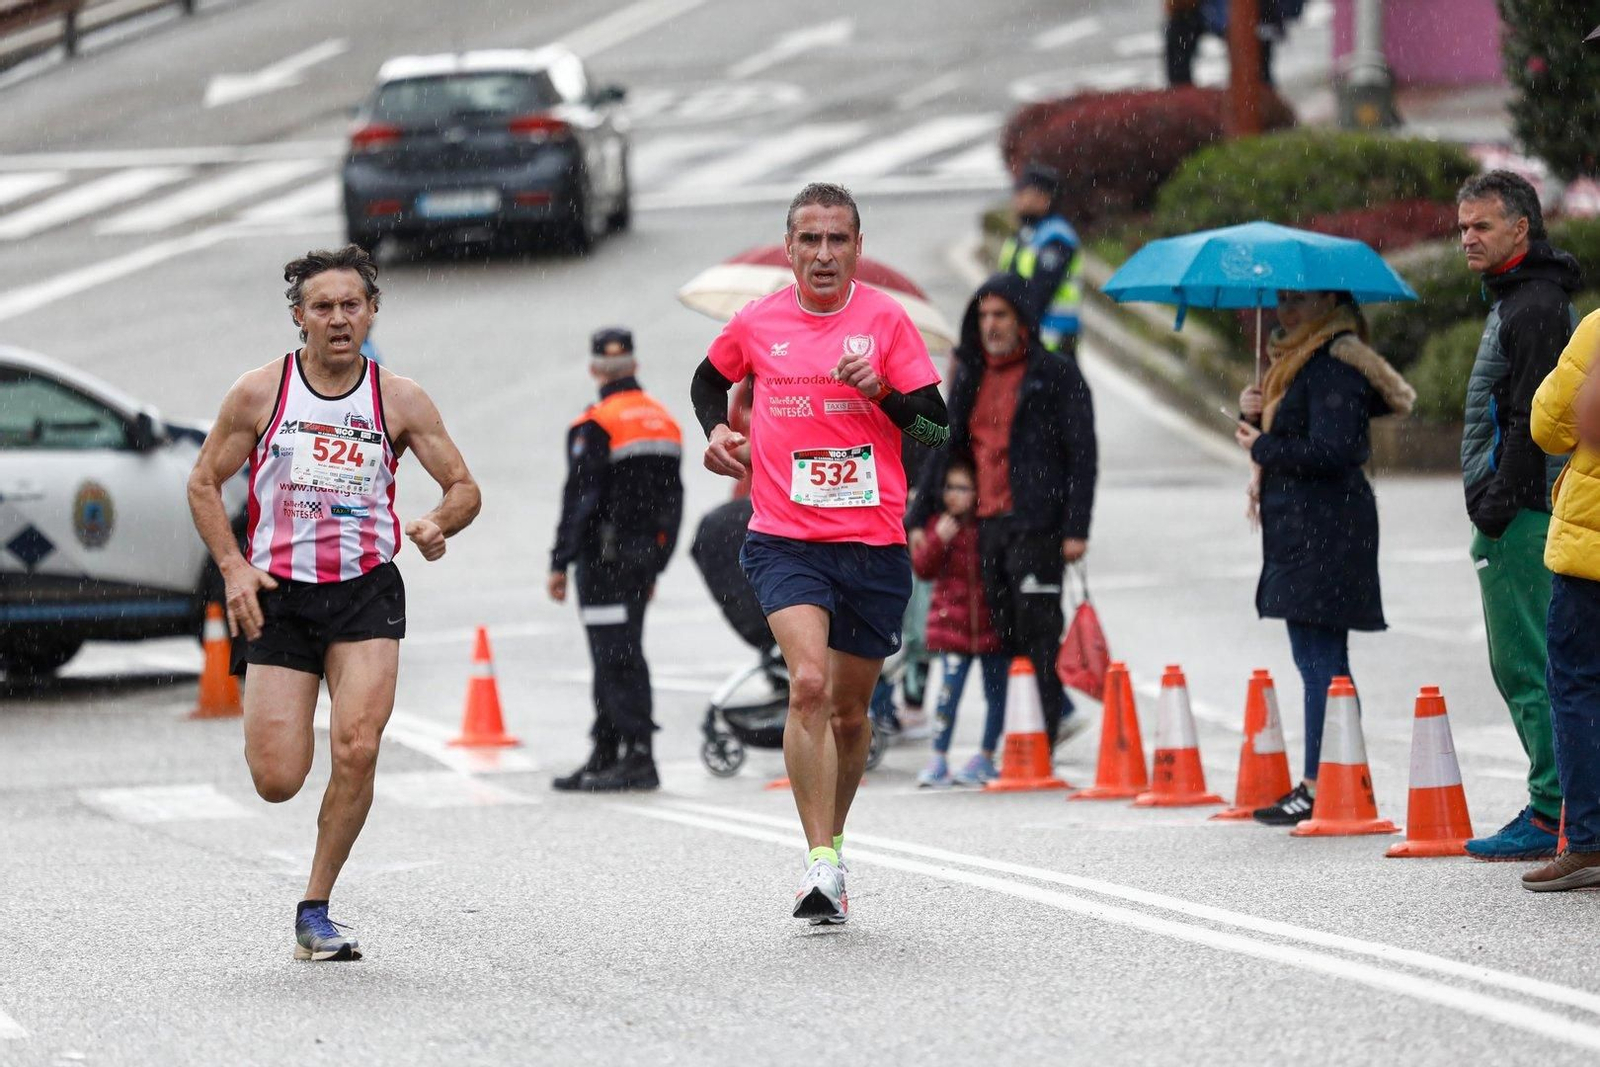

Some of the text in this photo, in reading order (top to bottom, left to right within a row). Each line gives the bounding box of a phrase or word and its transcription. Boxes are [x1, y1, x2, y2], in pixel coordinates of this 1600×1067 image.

[766, 375, 845, 388] www.rodavig
[769, 407, 814, 417] PONTESECA
[312, 436, 364, 467] 524
[810, 460, 858, 487] 532
[284, 508, 324, 519] PONTESECA
